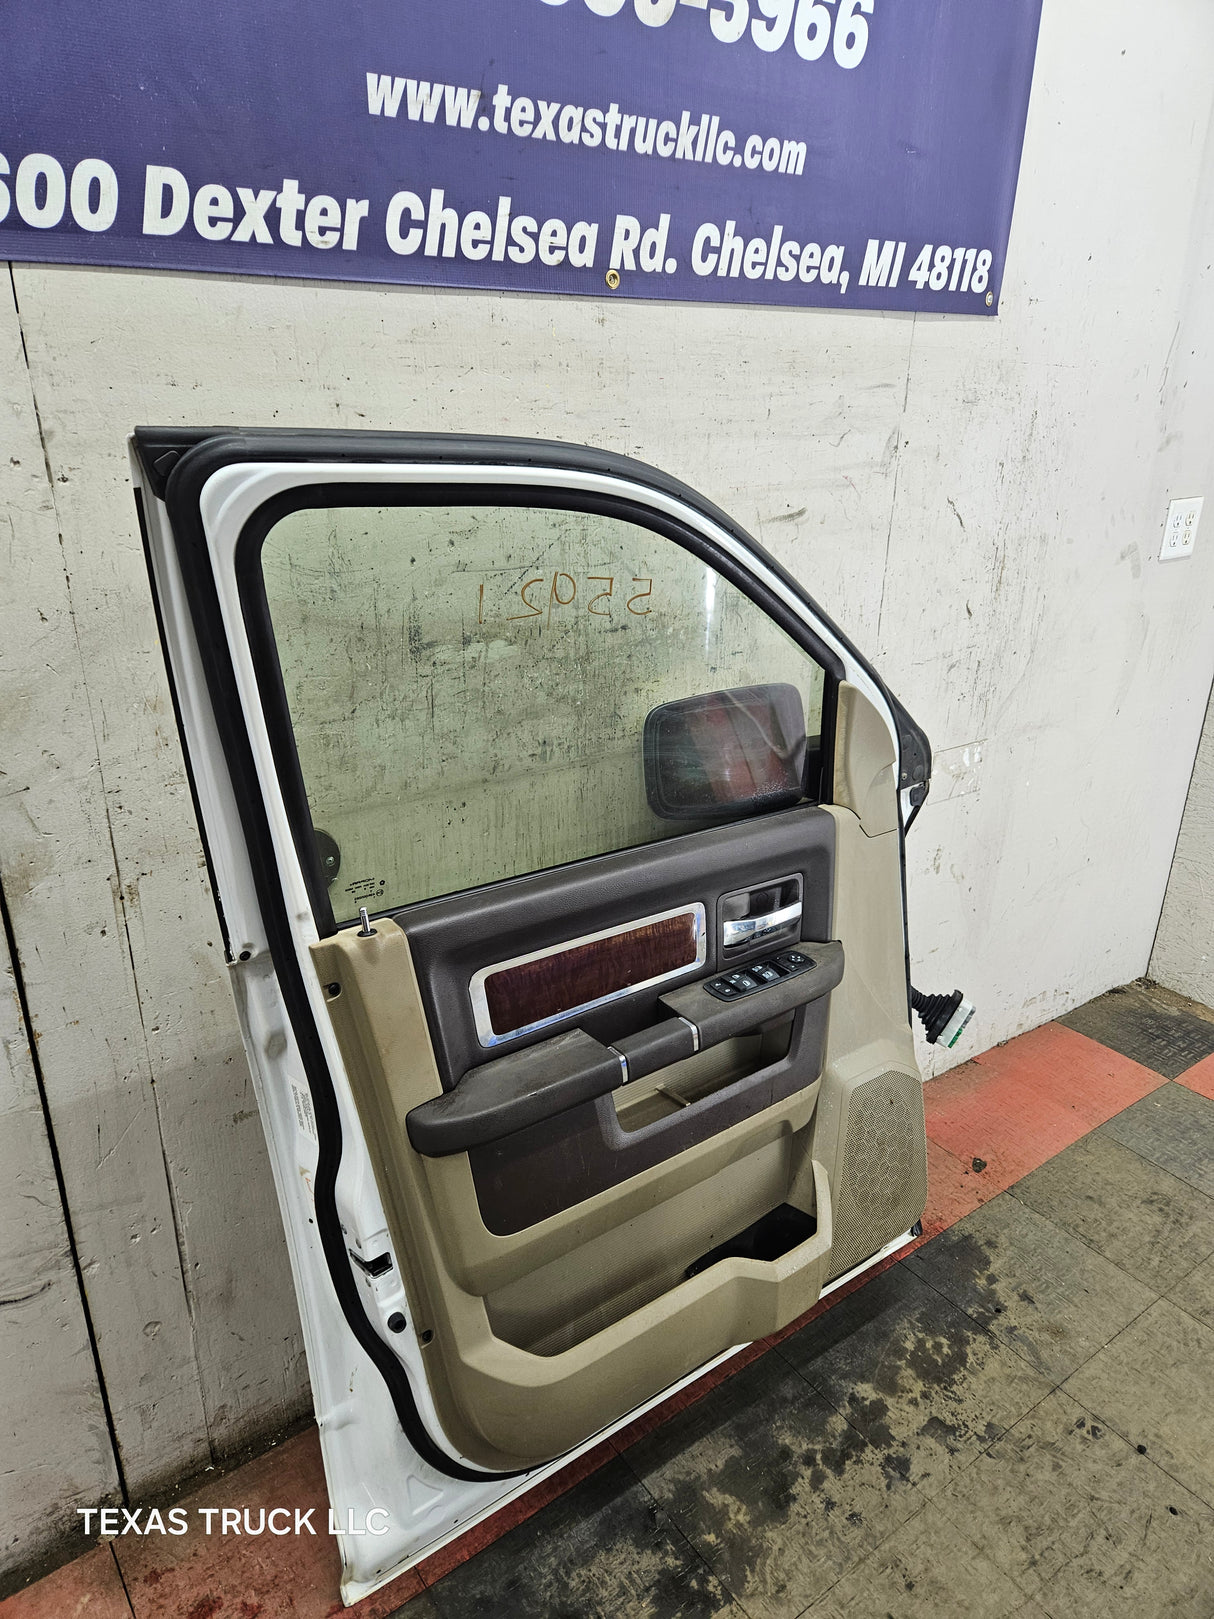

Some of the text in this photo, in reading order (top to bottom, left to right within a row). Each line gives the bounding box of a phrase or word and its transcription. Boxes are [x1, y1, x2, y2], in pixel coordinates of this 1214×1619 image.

[366, 72, 807, 176] www.texastruckllc.com
[0, 152, 994, 295] 00 Dexter Chelsea Rd. Chelsea, MI 48118
